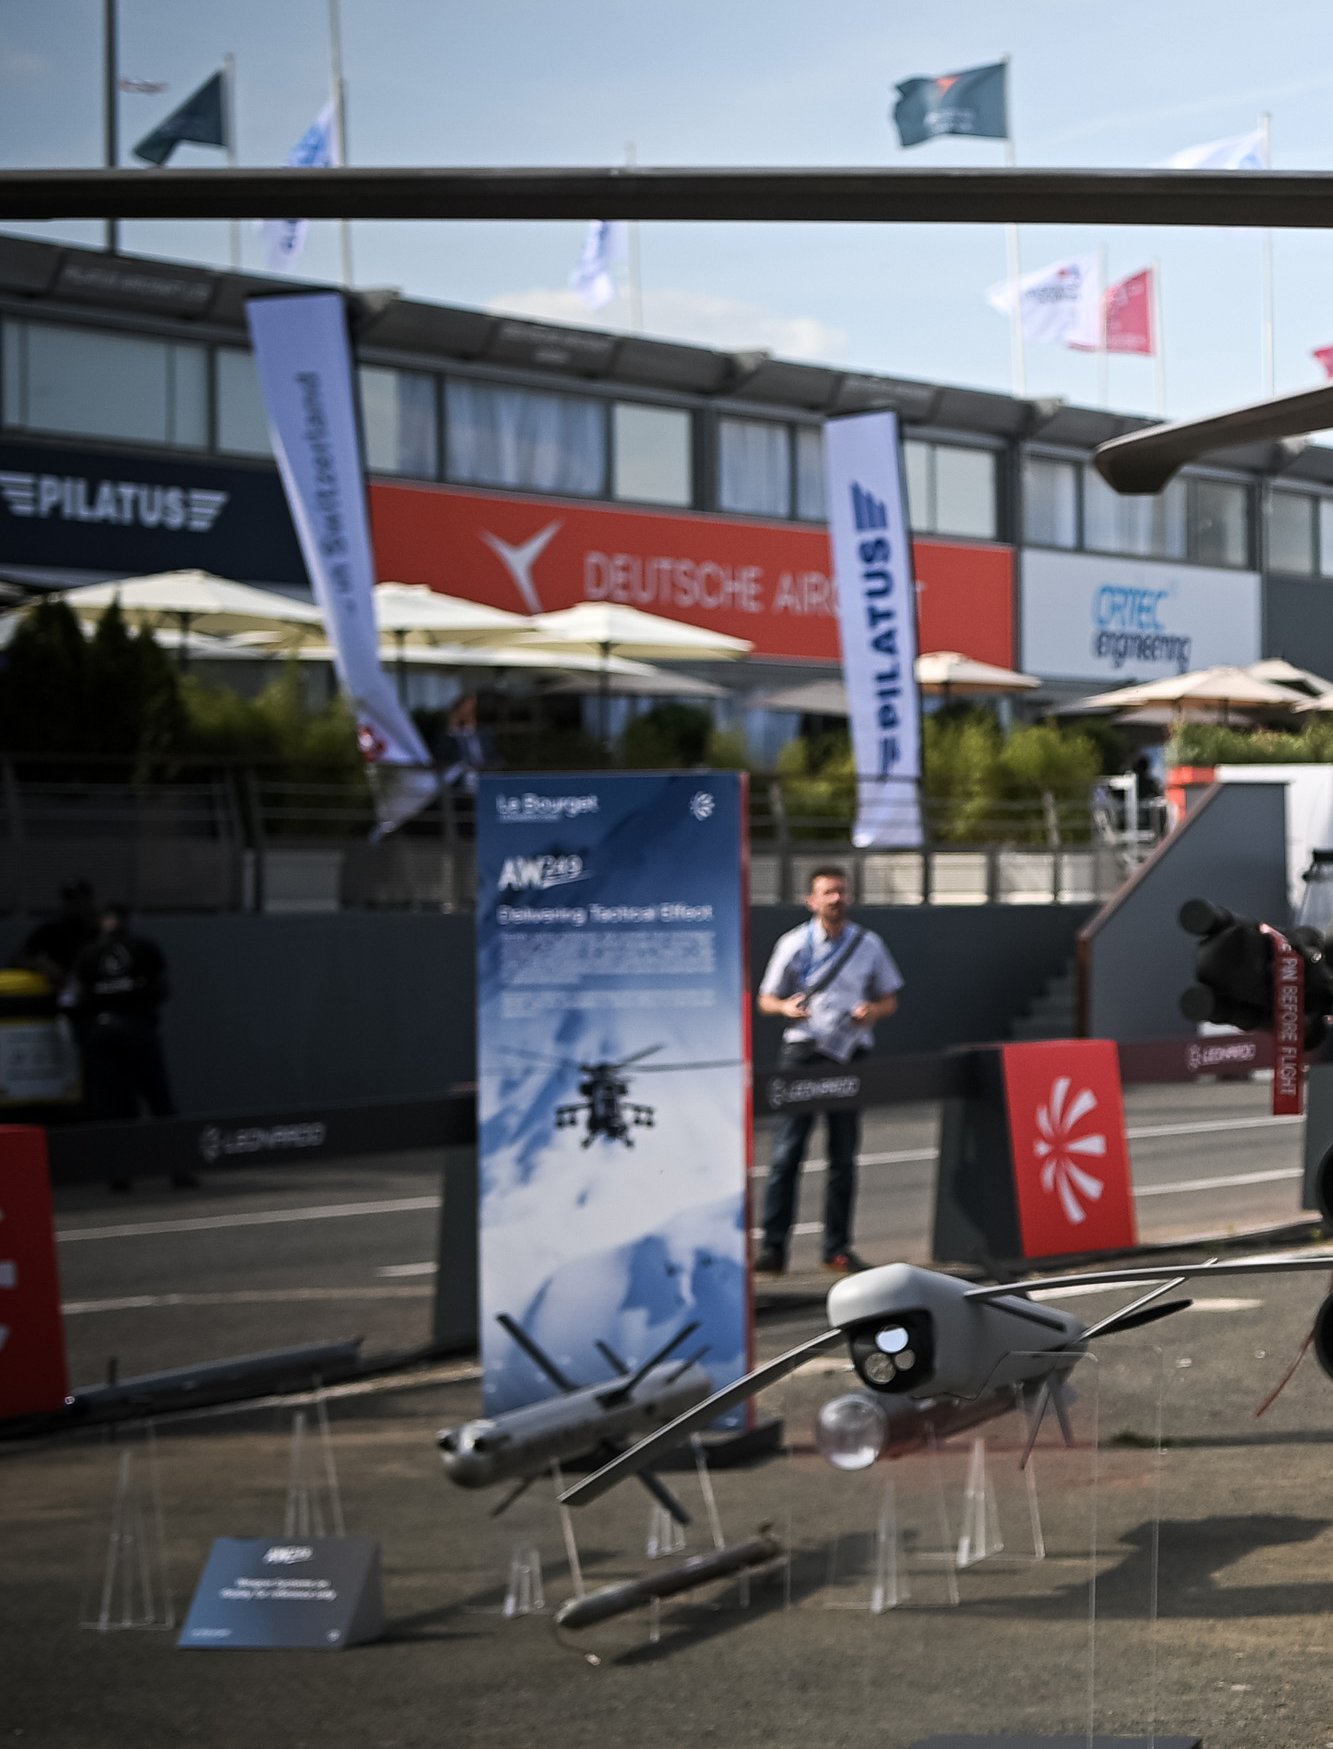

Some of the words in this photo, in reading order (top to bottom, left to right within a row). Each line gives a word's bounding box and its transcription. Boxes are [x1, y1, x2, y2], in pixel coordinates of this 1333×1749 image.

[38, 474, 187, 531] PILATUS
[583, 550, 764, 614] DEUTSCHE
[857, 536, 902, 732] PILATUS
[1279, 985, 1298, 1042] BEFORE
[1279, 1046, 1298, 1097] FLIGHT
